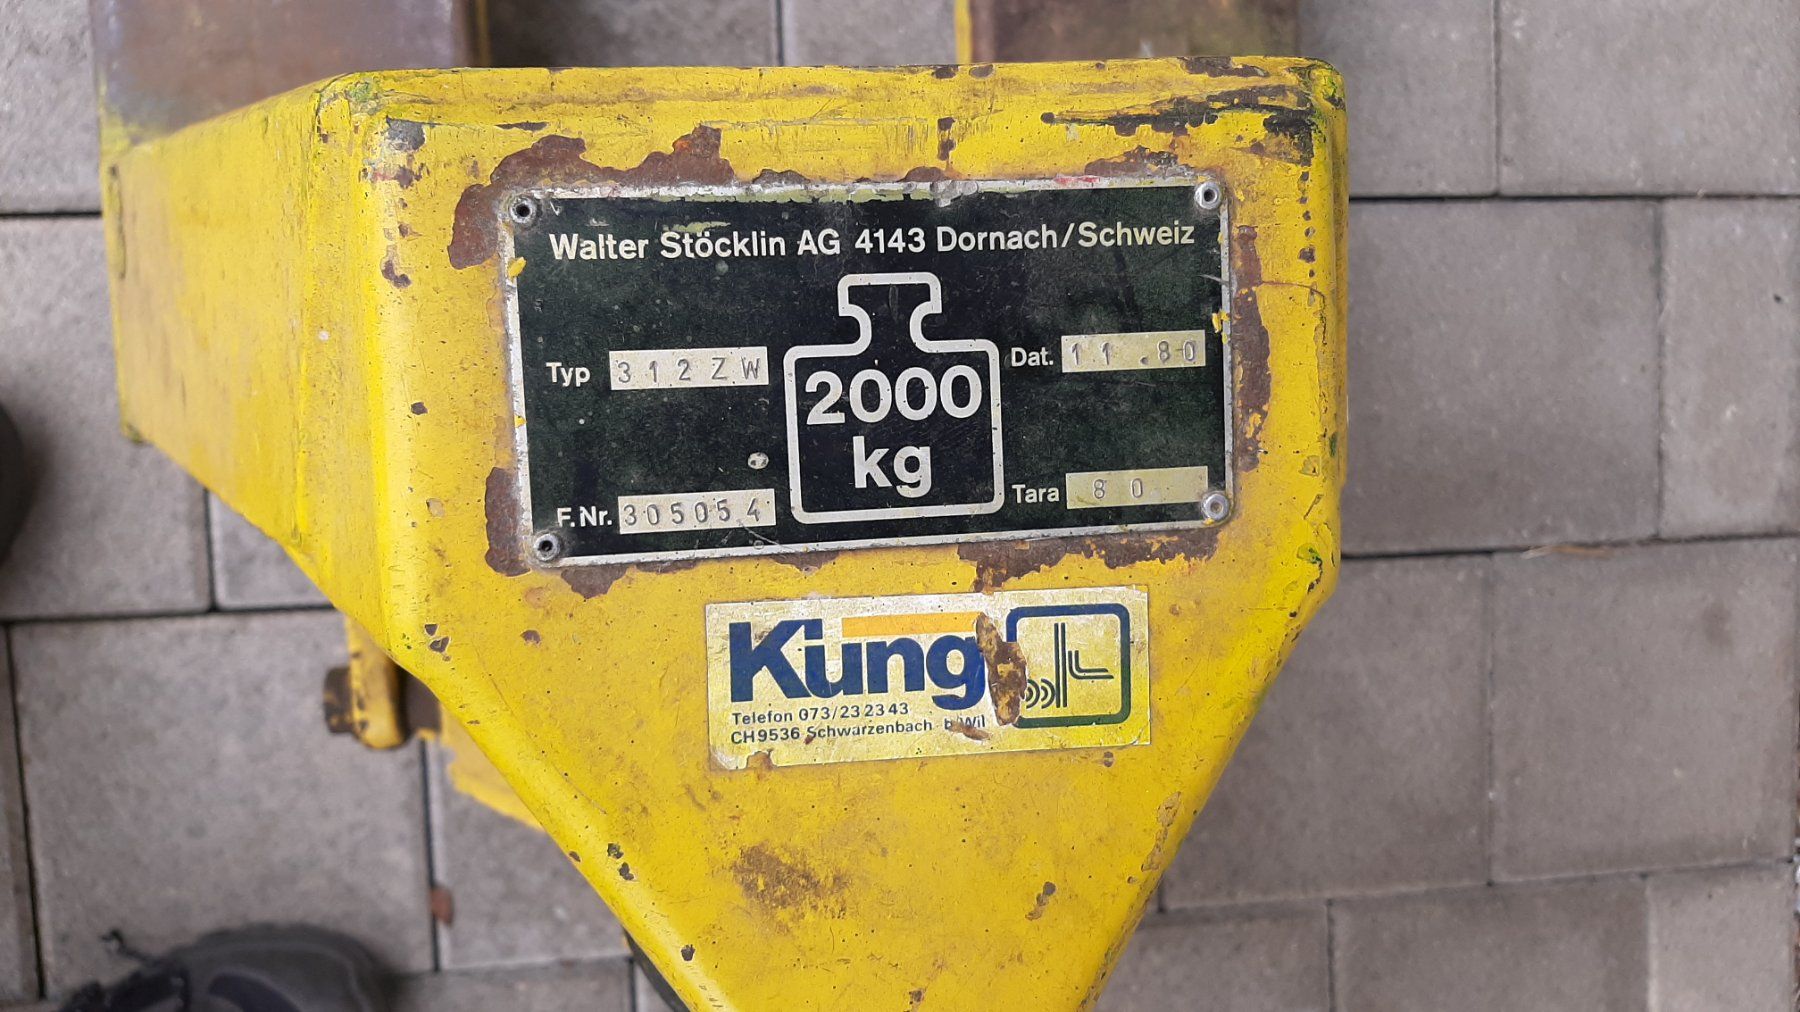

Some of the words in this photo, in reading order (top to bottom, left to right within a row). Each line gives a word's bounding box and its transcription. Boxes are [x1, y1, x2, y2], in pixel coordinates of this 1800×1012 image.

[550, 233, 649, 261] Walter
[660, 230, 787, 259] Stöcklin
[797, 228, 841, 256] AG
[854, 227, 926, 254] 4143
[936, 220, 1195, 252] Dornach/Schweiz
[1011, 347, 1054, 368] Dat.
[546, 360, 591, 388] Typ
[805, 364, 983, 426] 2000
[852, 435, 932, 499] kg
[1012, 484, 1060, 504] Tara
[556, 505, 613, 528] F.Nr.
[732, 710, 793, 726] Telefon
[806, 719, 933, 739] Schwarzenbach
